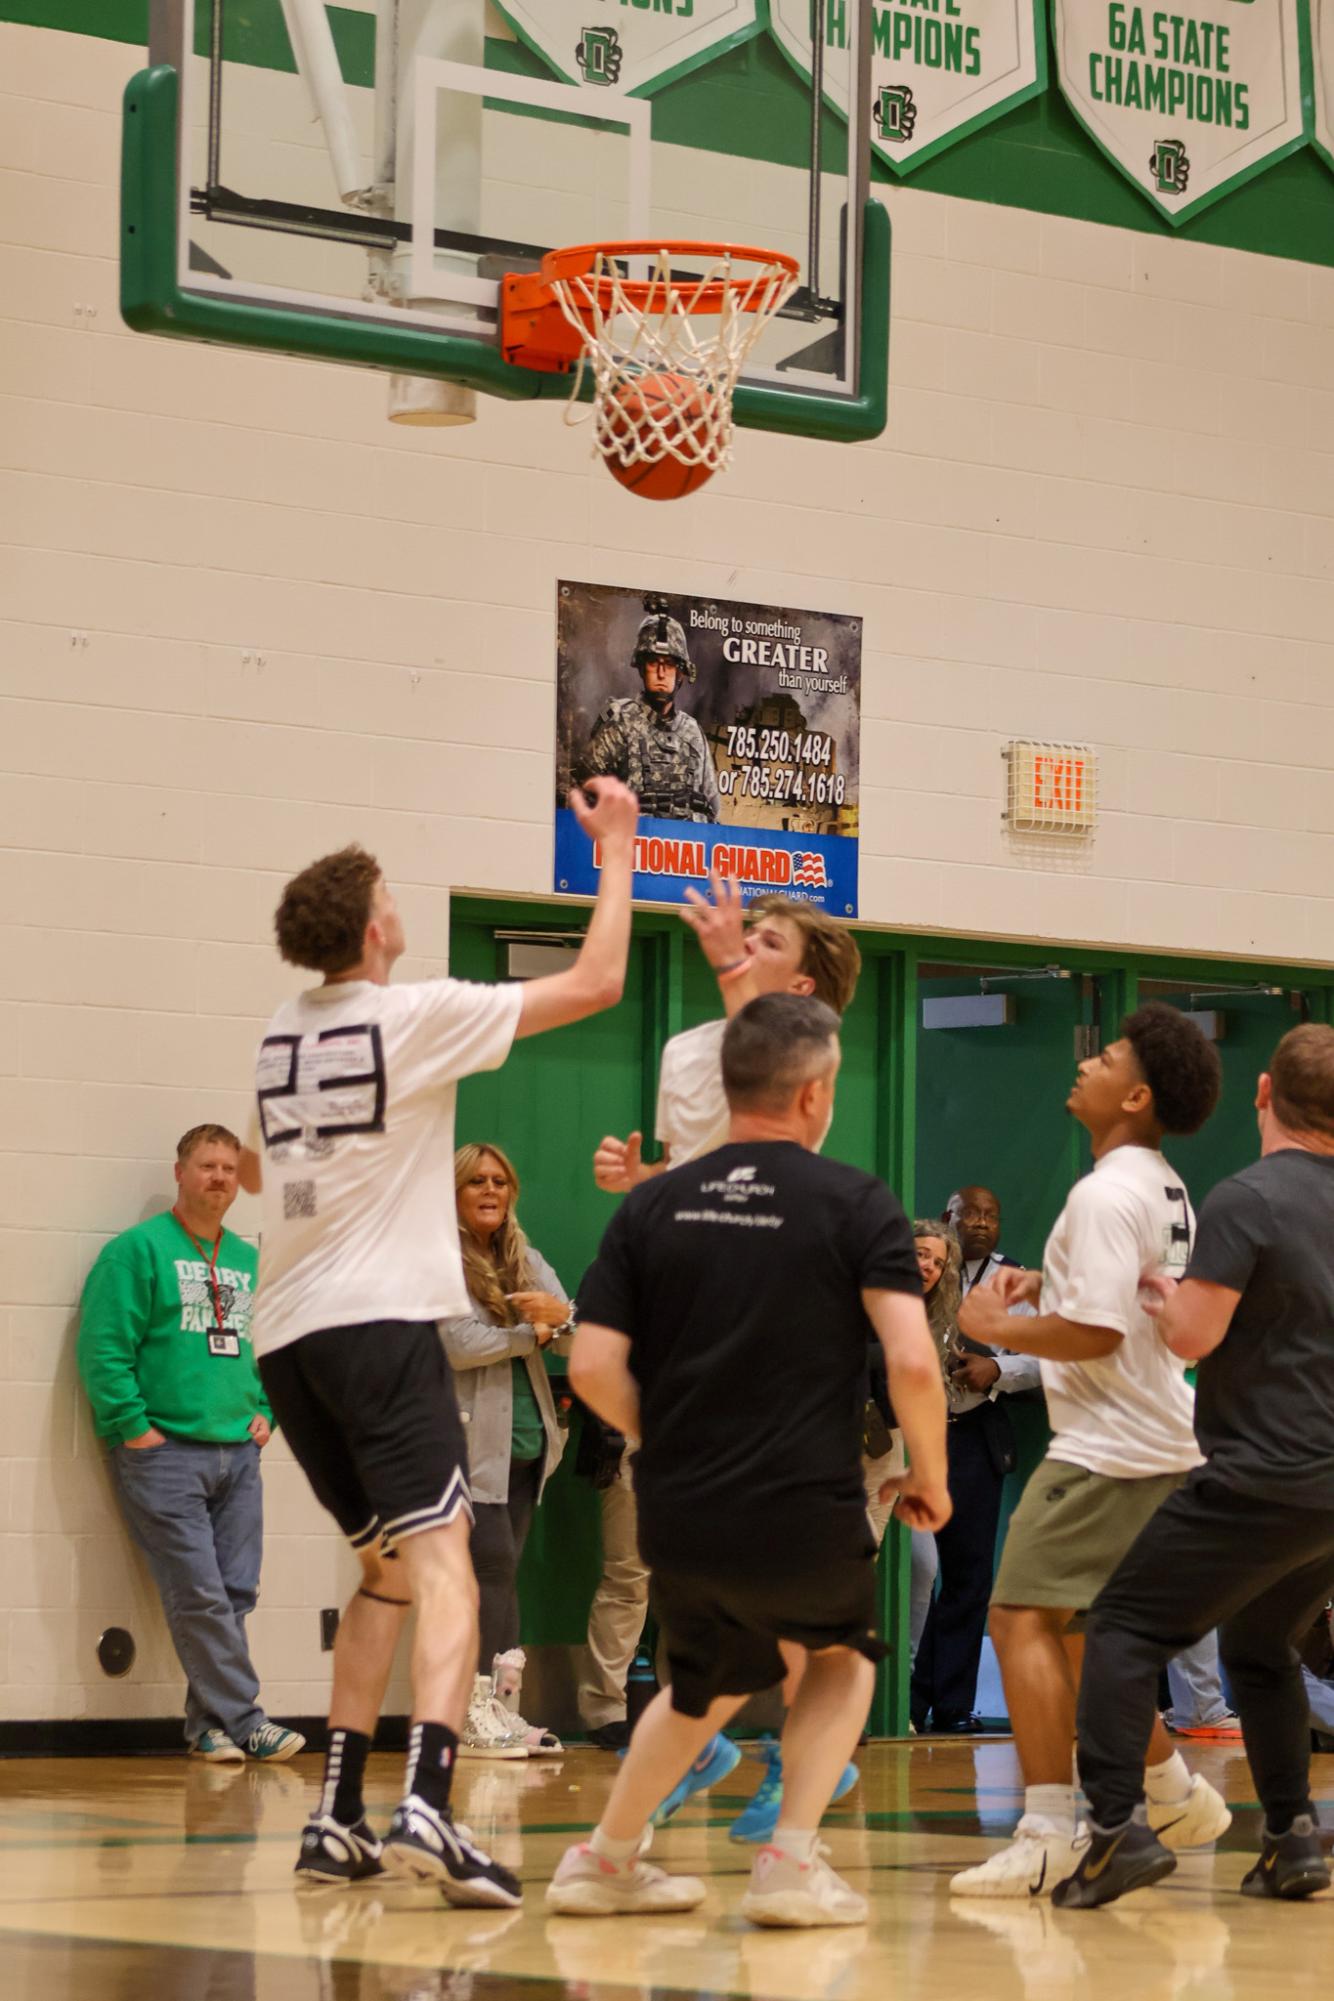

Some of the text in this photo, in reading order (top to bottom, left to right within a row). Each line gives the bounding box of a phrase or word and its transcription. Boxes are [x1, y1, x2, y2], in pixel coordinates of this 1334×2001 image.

[809, 0, 981, 76] HMPIONS
[1108, 1, 1231, 74] 6A STATE
[1088, 52, 1250, 131] CHAMPIONS
[690, 609, 801, 645] Belong to something
[723, 637, 829, 673] GREATER
[778, 668, 848, 697] than yourself
[727, 725, 832, 766] 785.250.1484
[719, 765, 845, 806] or 785.274.1618
[1034, 755, 1085, 812] EXIT
[593, 835, 792, 886] TIONAL GUARD
